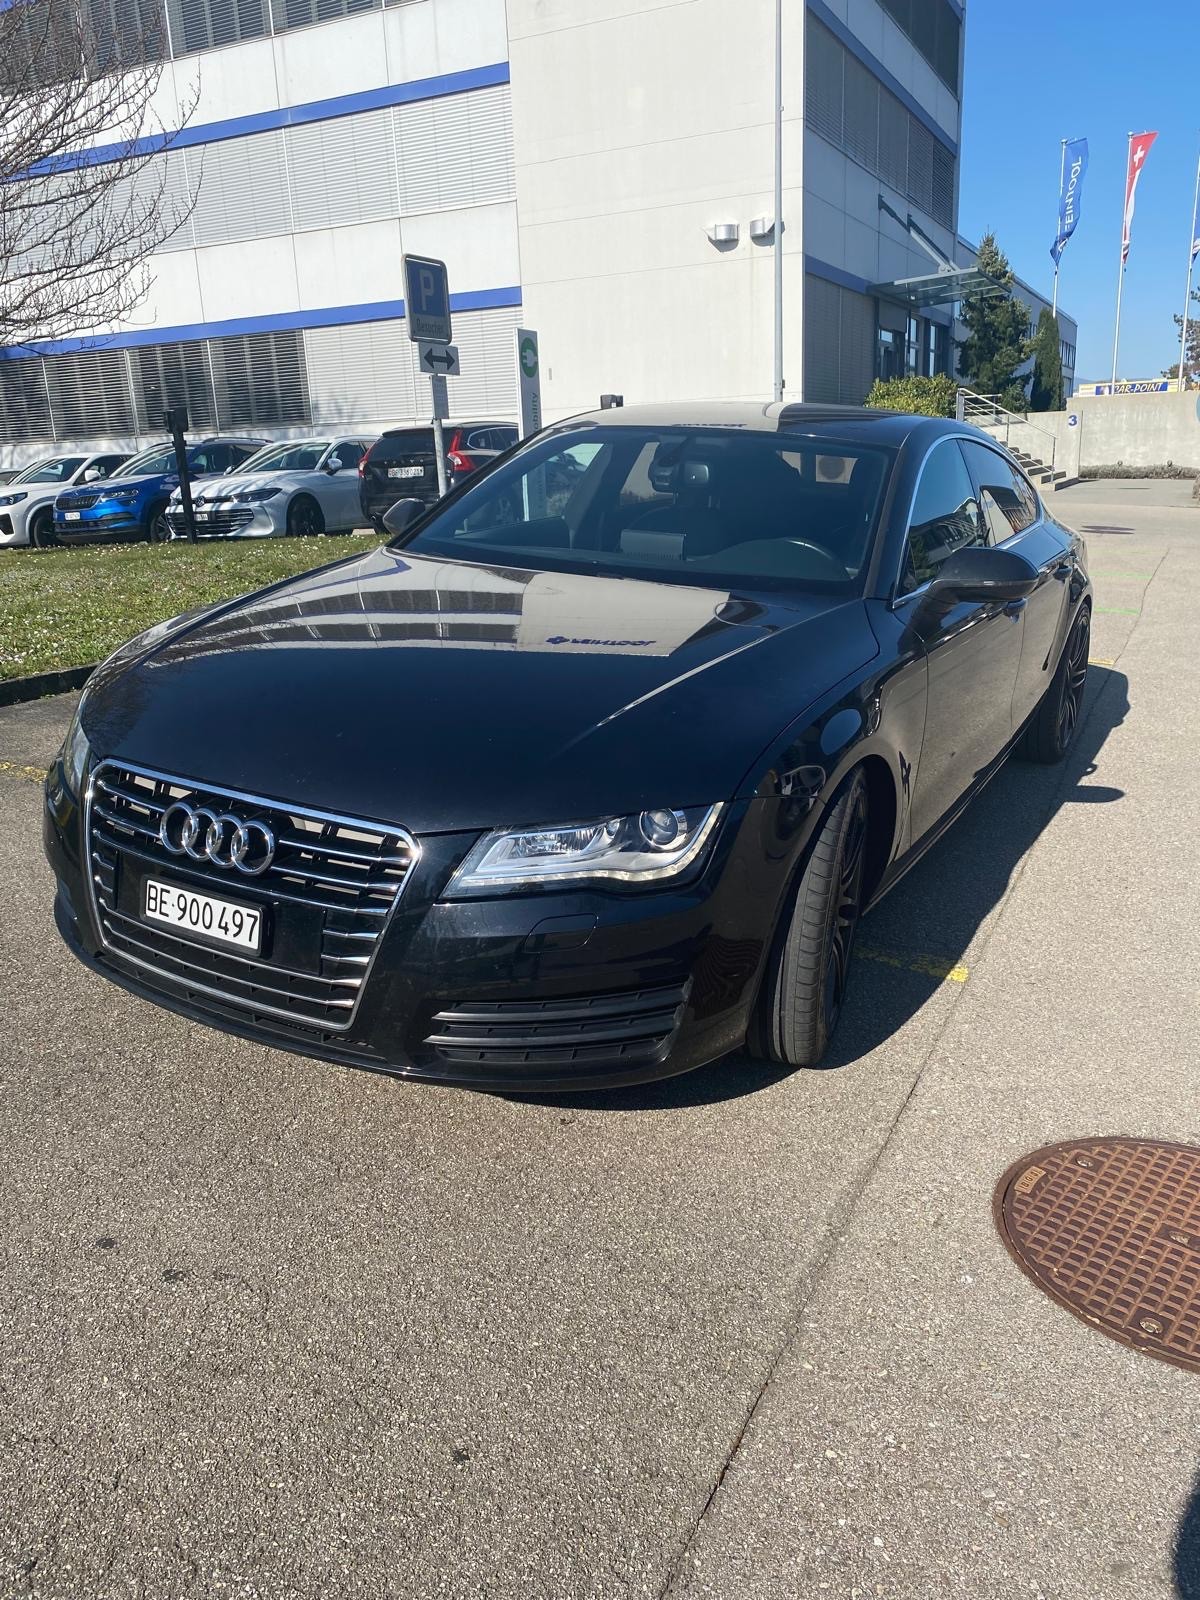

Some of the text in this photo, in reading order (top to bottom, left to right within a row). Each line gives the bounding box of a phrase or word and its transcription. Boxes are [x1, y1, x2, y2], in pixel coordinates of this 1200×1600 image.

[418, 269, 434, 311] P
[530, 391, 539, 432] obility
[1068, 415, 1078, 427] 3
